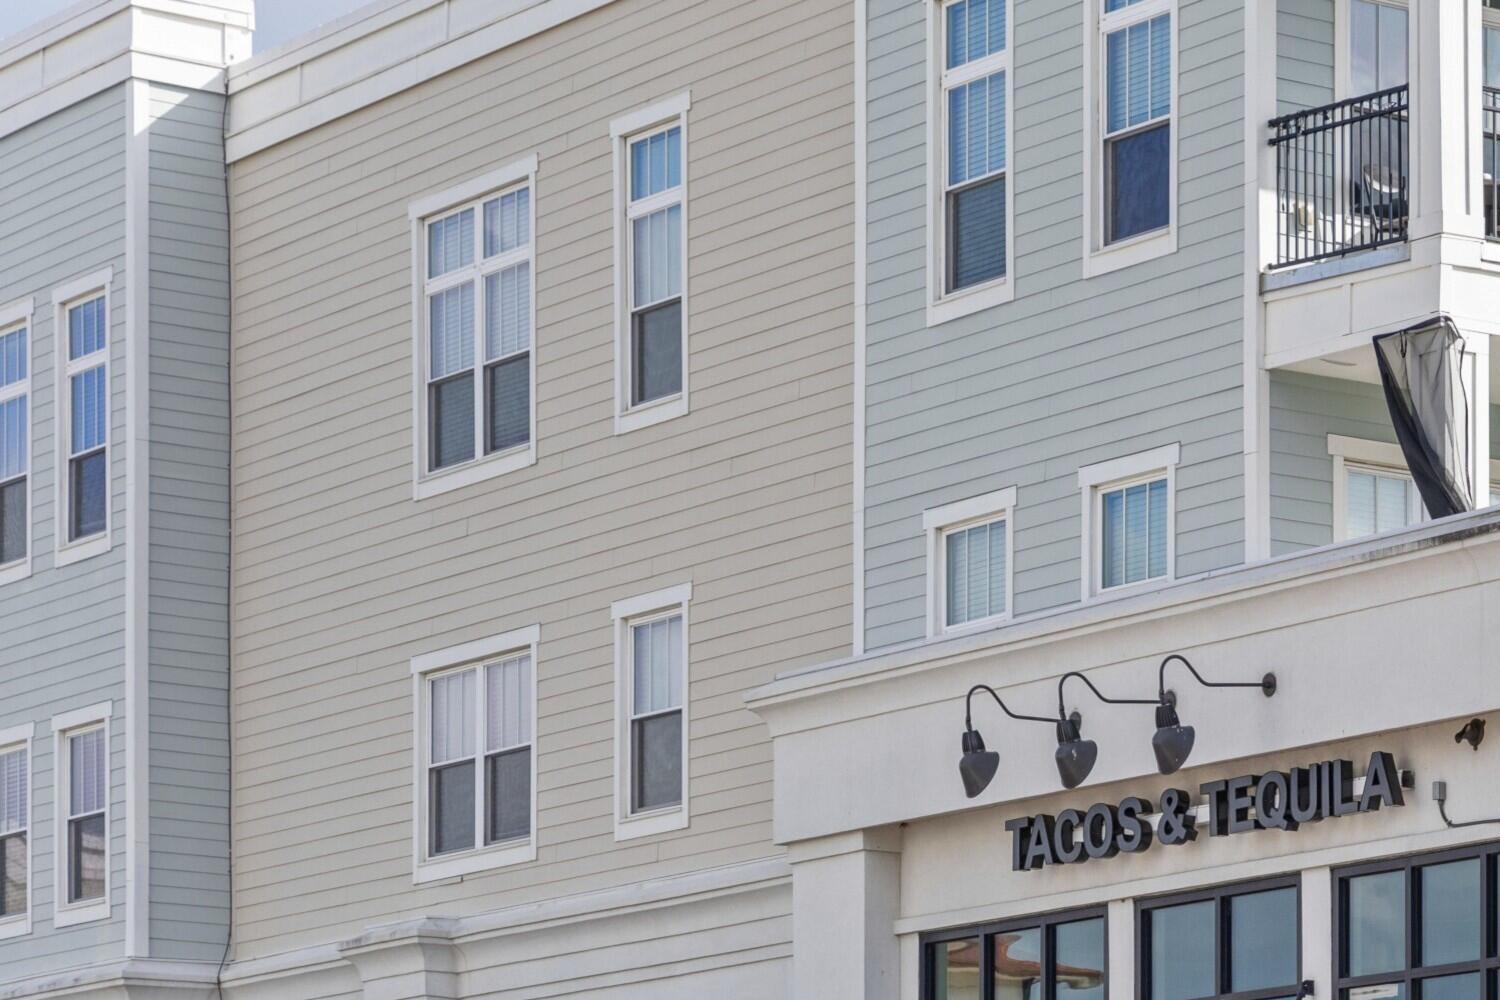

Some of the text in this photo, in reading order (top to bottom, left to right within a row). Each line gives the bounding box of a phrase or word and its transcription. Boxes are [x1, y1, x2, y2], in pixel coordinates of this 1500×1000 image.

[1005, 751, 1404, 872] TACOS & TEQUILA
